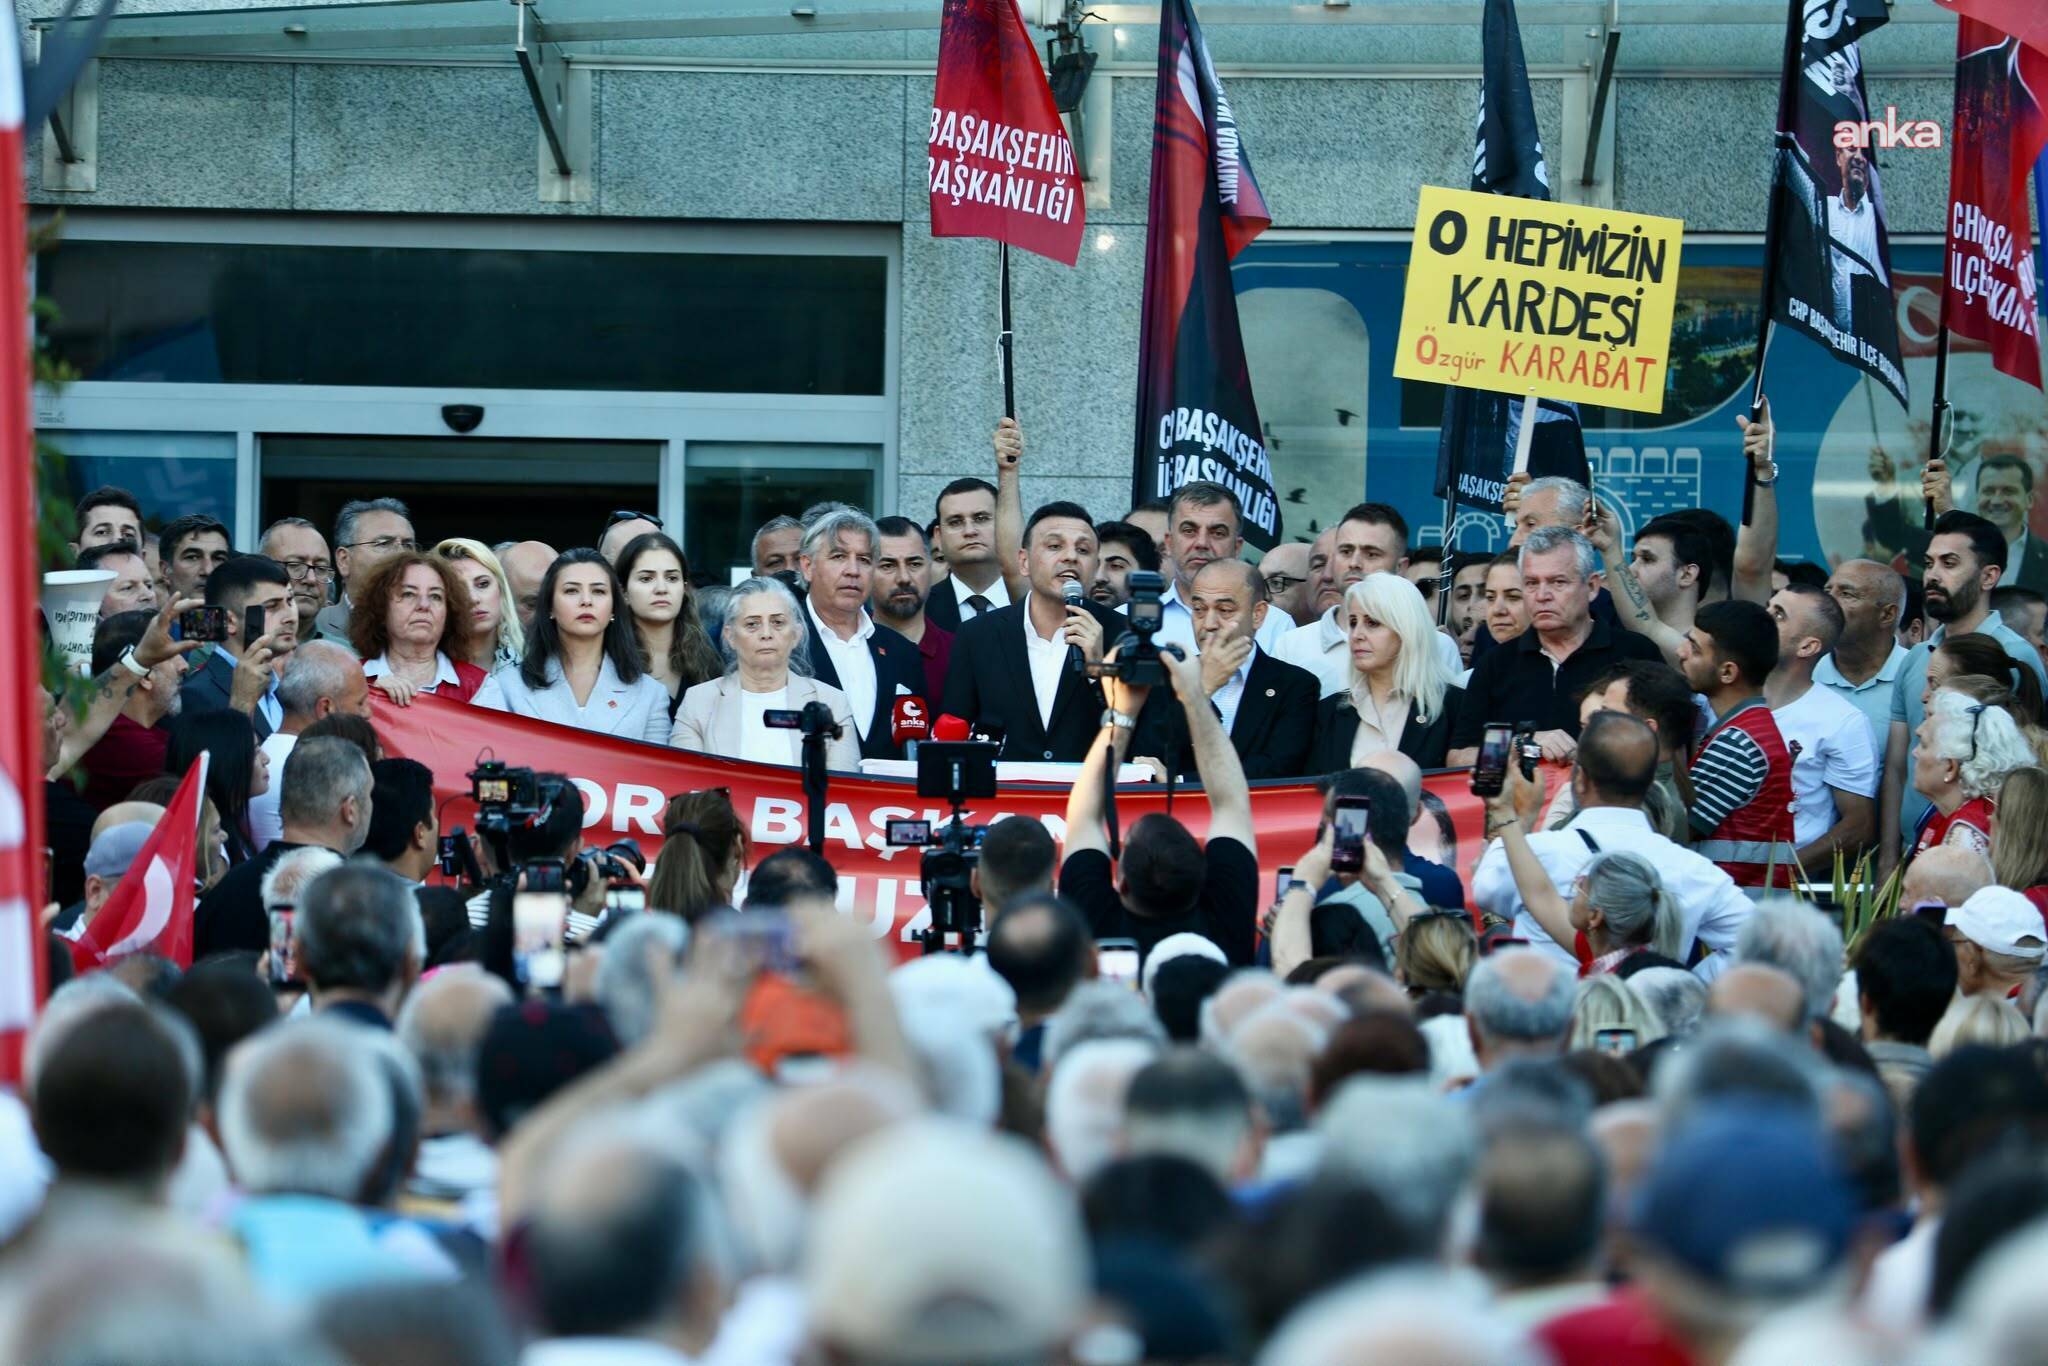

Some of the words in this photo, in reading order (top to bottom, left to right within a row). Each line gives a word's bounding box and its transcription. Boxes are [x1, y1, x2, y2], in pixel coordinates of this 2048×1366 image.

[1429, 210, 1467, 255] O
[1486, 219, 1666, 283] HEPİMİZİN
[1448, 274, 1644, 351] KARDEŞİ
[1789, 297, 1809, 322] CHP
[1415, 326, 1485, 382] Özgür
[1499, 340, 1657, 393] KARABAT
